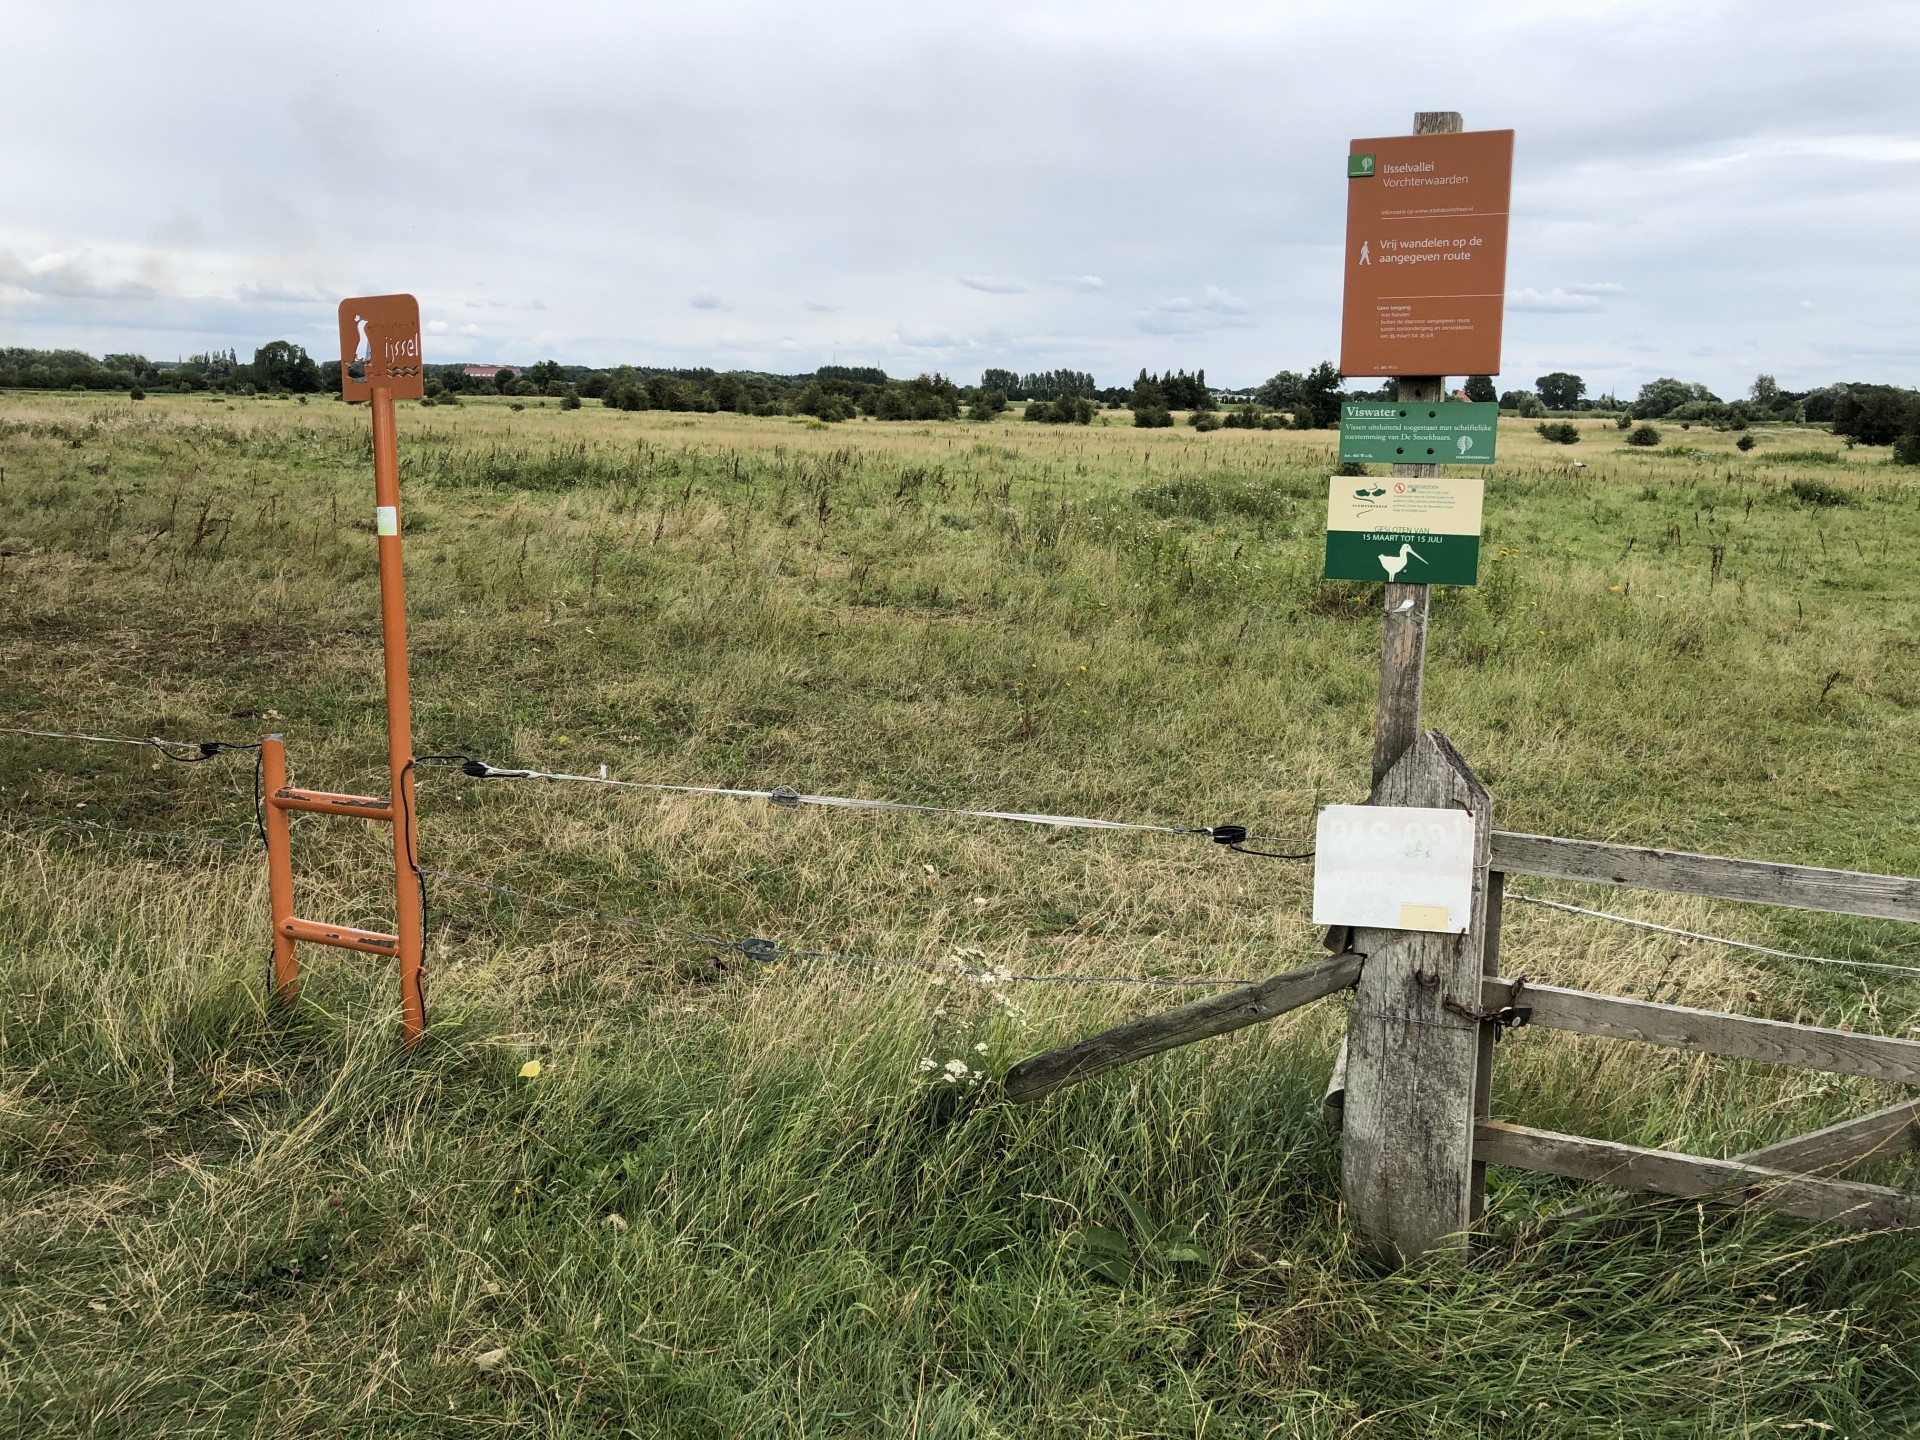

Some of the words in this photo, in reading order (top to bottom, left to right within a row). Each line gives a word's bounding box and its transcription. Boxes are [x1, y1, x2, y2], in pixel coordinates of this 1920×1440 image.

[1382, 174, 1469, 188] Vorchterwaarden
[1379, 239, 1397, 251] Vrij
[1400, 237, 1449, 249] wandelen
[1452, 238, 1466, 248] op
[1469, 236, 1483, 246] de
[1379, 253, 1440, 265] aangegeven
[1443, 251, 1471, 261] route
[385, 333, 418, 366] ijssel
[1345, 406, 1396, 417] Viswater
[1345, 423, 1367, 431] Vissen
[1368, 423, 1402, 431] uitsluitend
[1403, 424, 1438, 433] toegestaan
[1453, 423, 1492, 433] schriftelijke
[1345, 434, 1386, 442] toestemming
[1401, 433, 1411, 441] De
[1374, 525, 1412, 534] GESLOTEN
[1362, 533, 1371, 541] 15
[1372, 534, 1398, 542] MAART
[1417, 535, 1426, 543] 15
[1427, 536, 1443, 544] JULI
